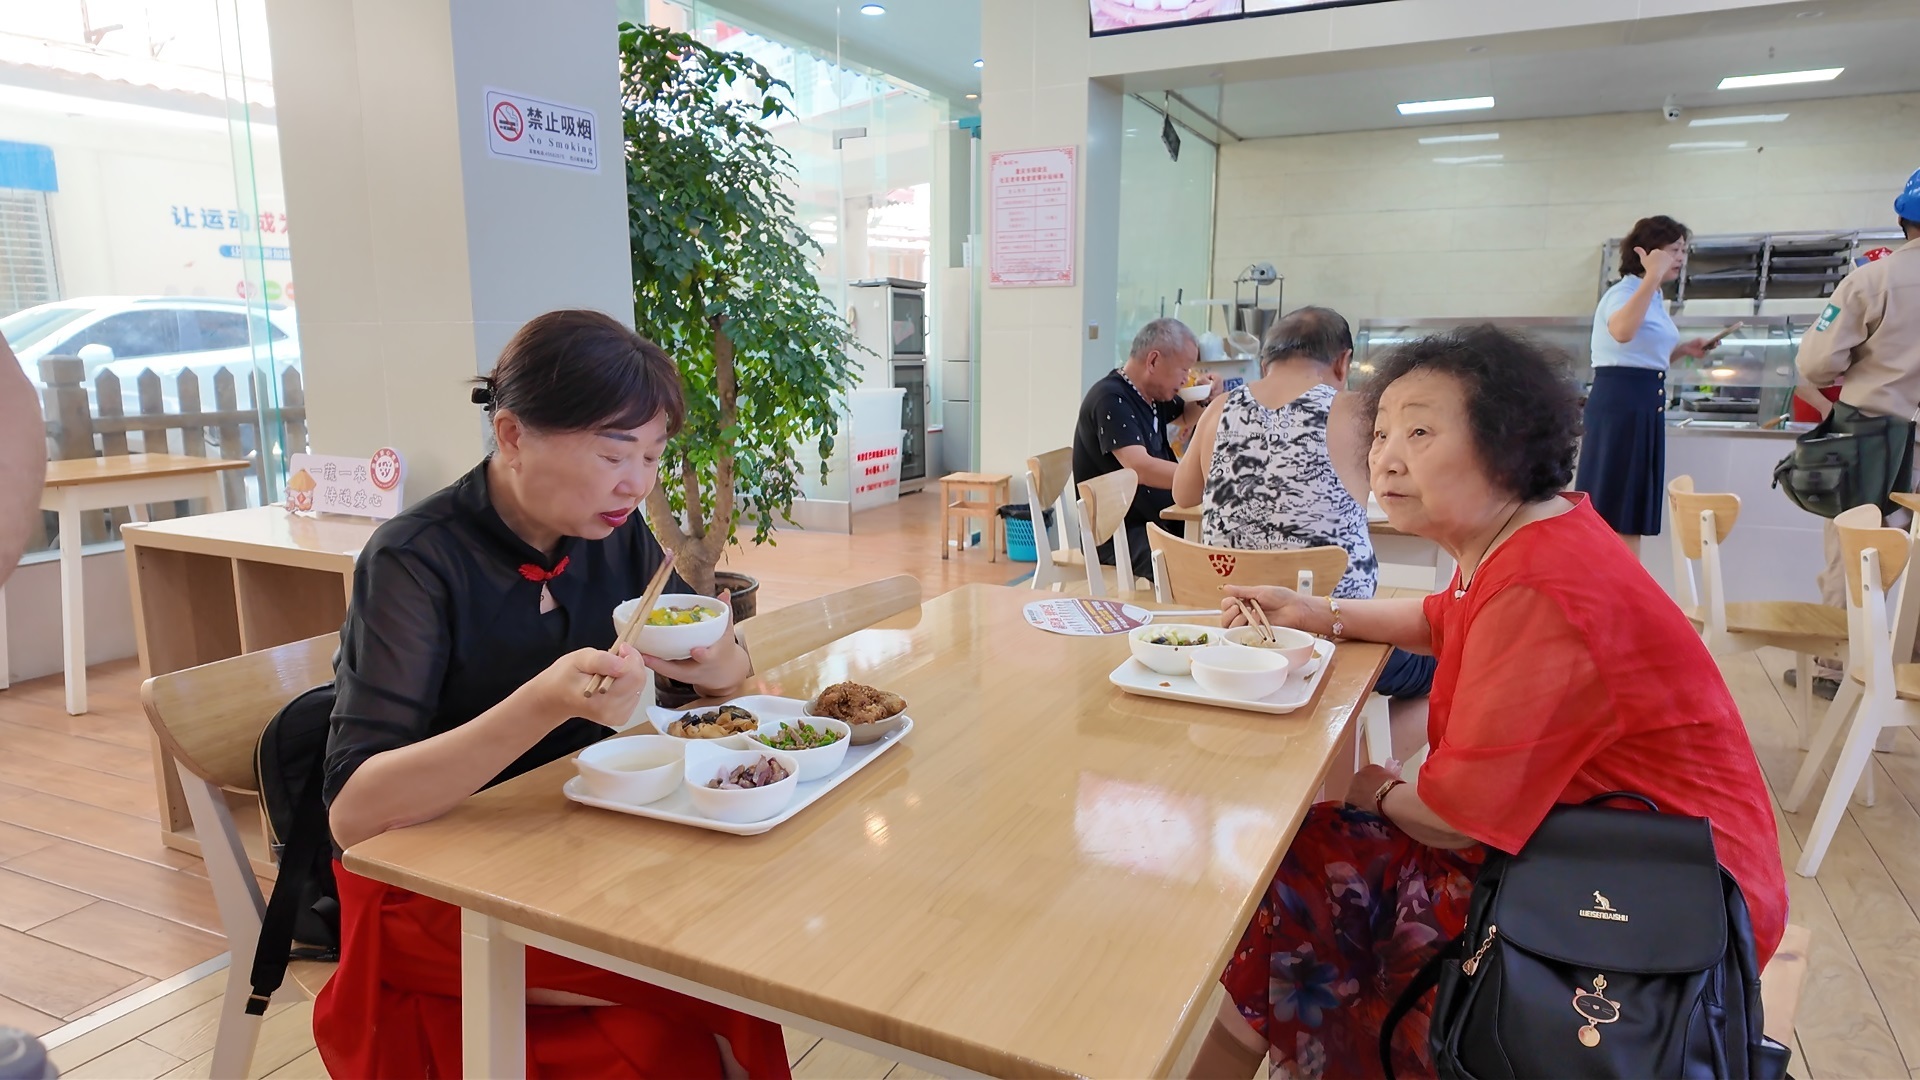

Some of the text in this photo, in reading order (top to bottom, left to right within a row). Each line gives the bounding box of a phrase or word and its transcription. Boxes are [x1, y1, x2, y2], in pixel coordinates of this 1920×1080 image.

[527, 107, 592, 140] 禁止吸烟
[528, 133, 542, 145] No
[548, 137, 594, 156] Smoking
